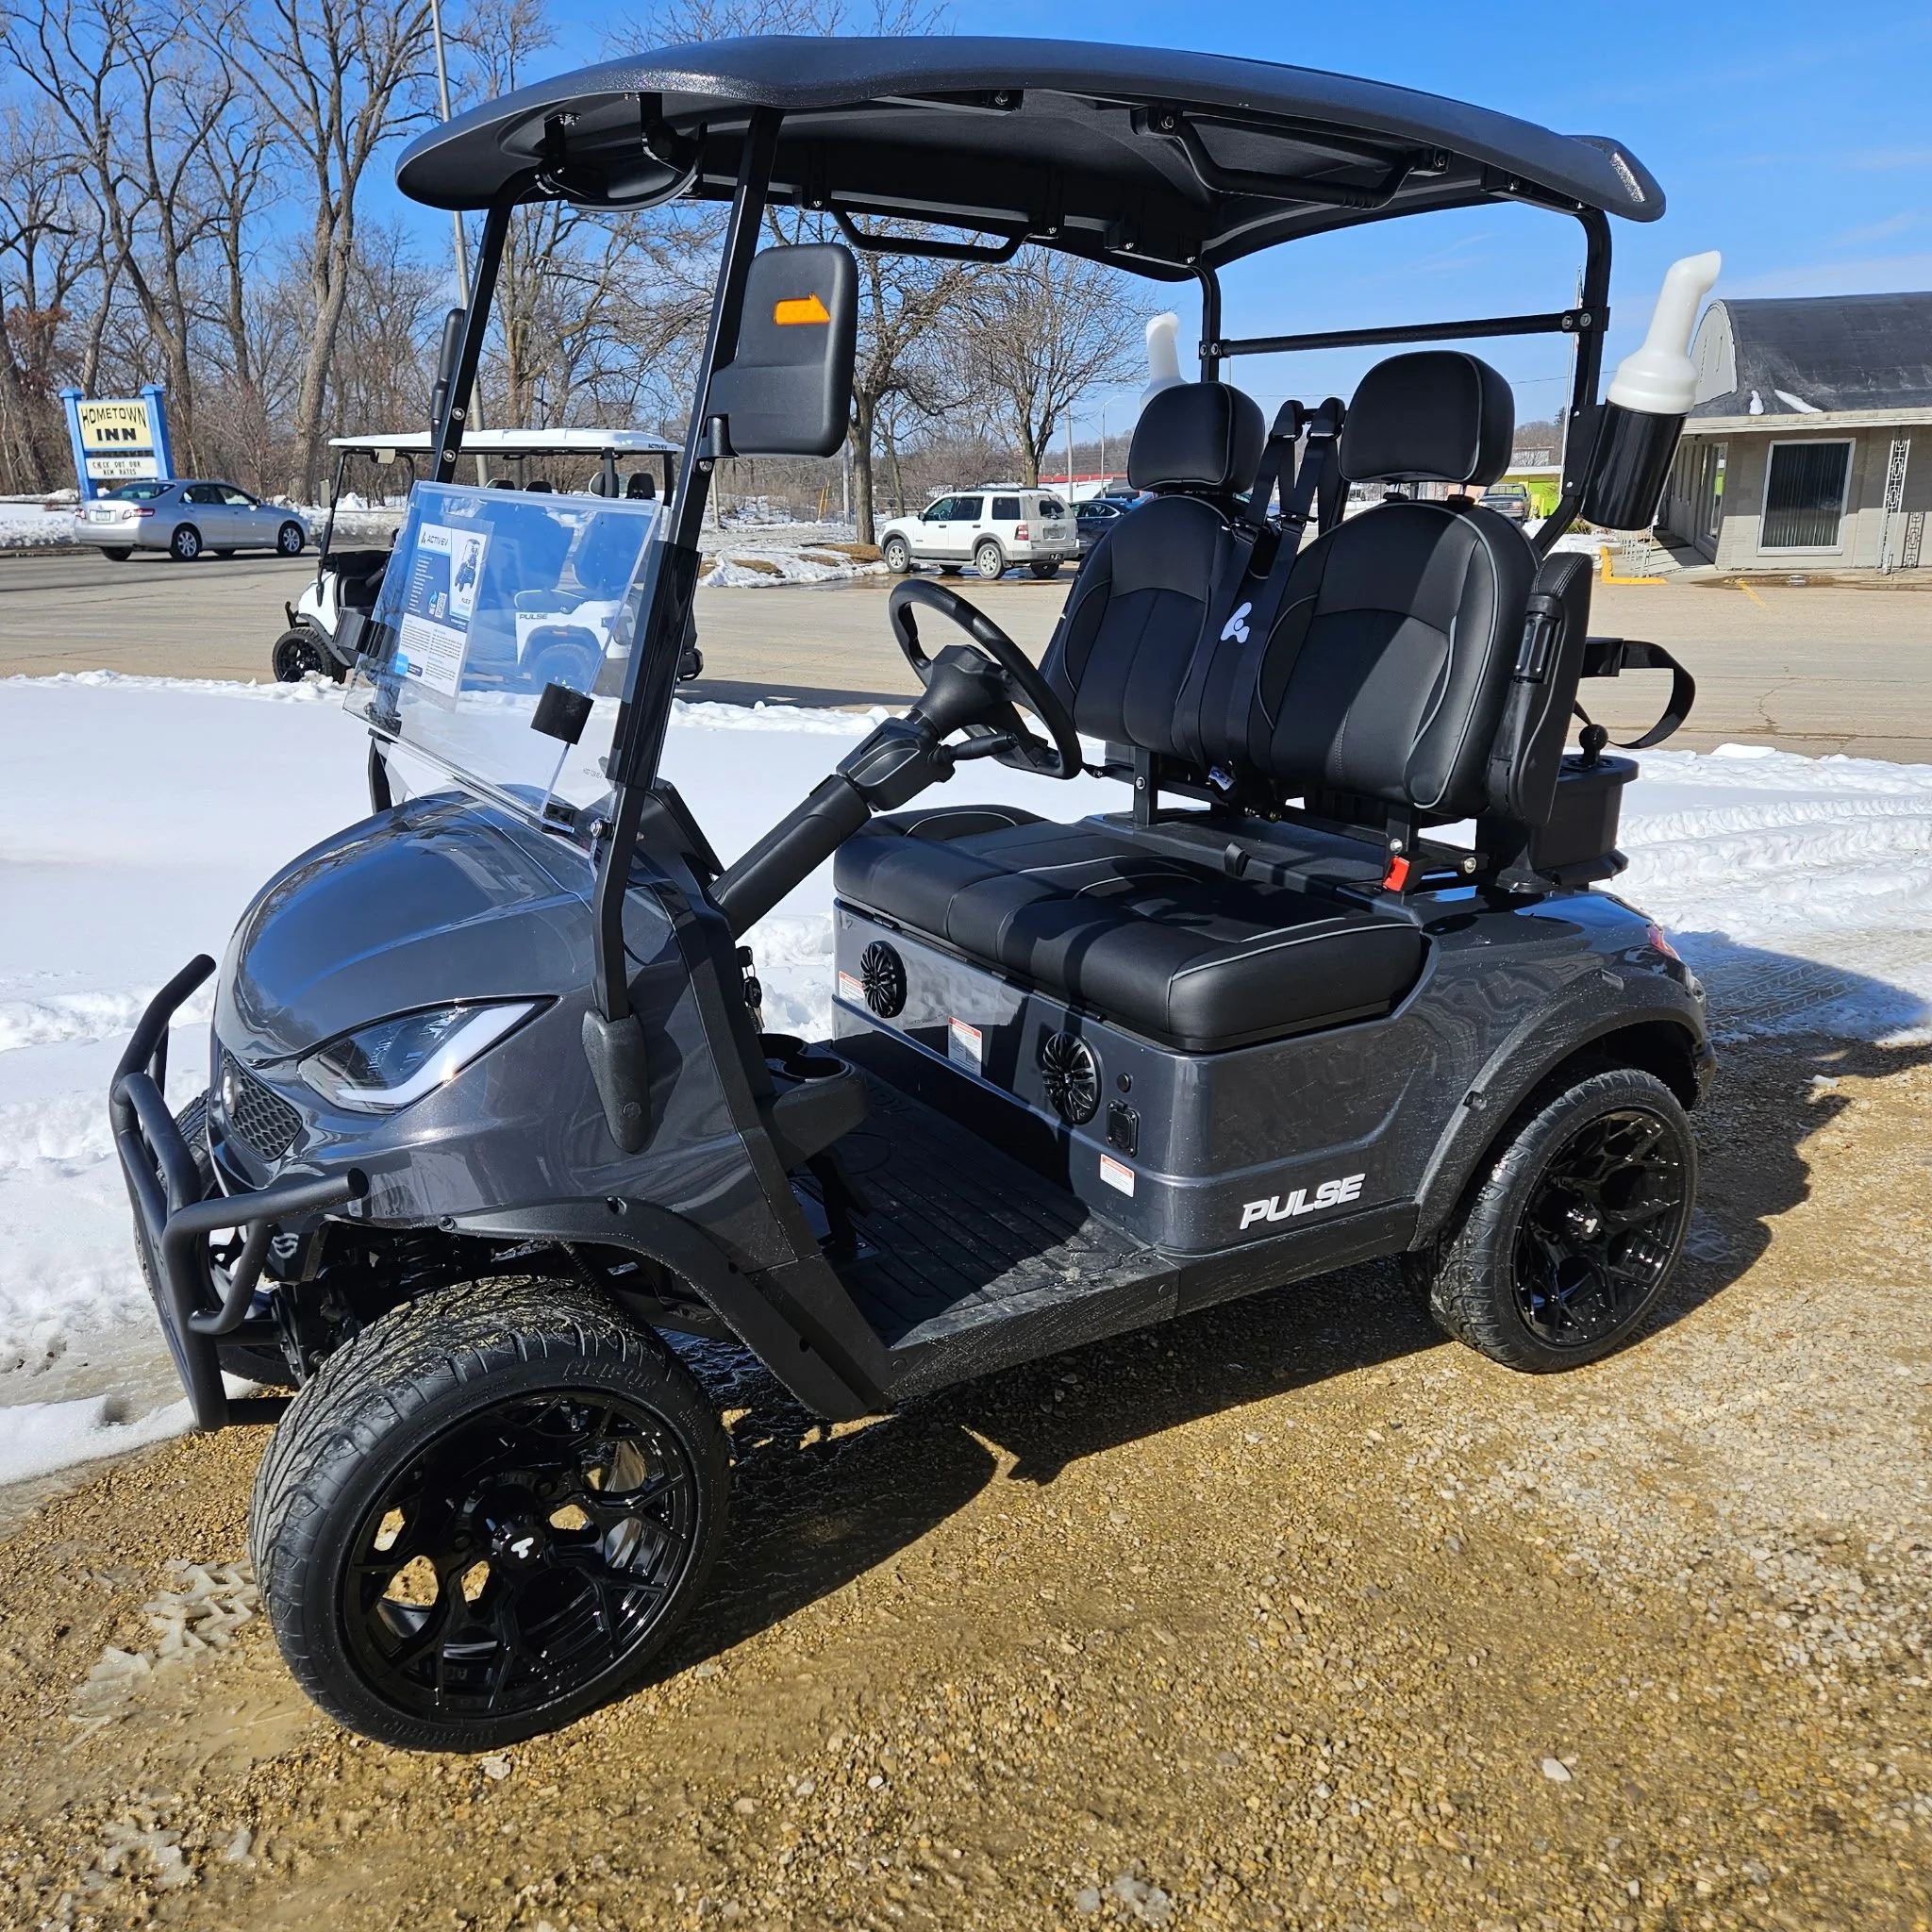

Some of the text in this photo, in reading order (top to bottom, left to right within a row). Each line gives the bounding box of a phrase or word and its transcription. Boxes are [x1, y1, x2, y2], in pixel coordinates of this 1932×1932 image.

[81, 406, 147, 430] HOMETOWN
[96, 427, 137, 441] INN
[1239, 1173, 1366, 1230] PULSE
